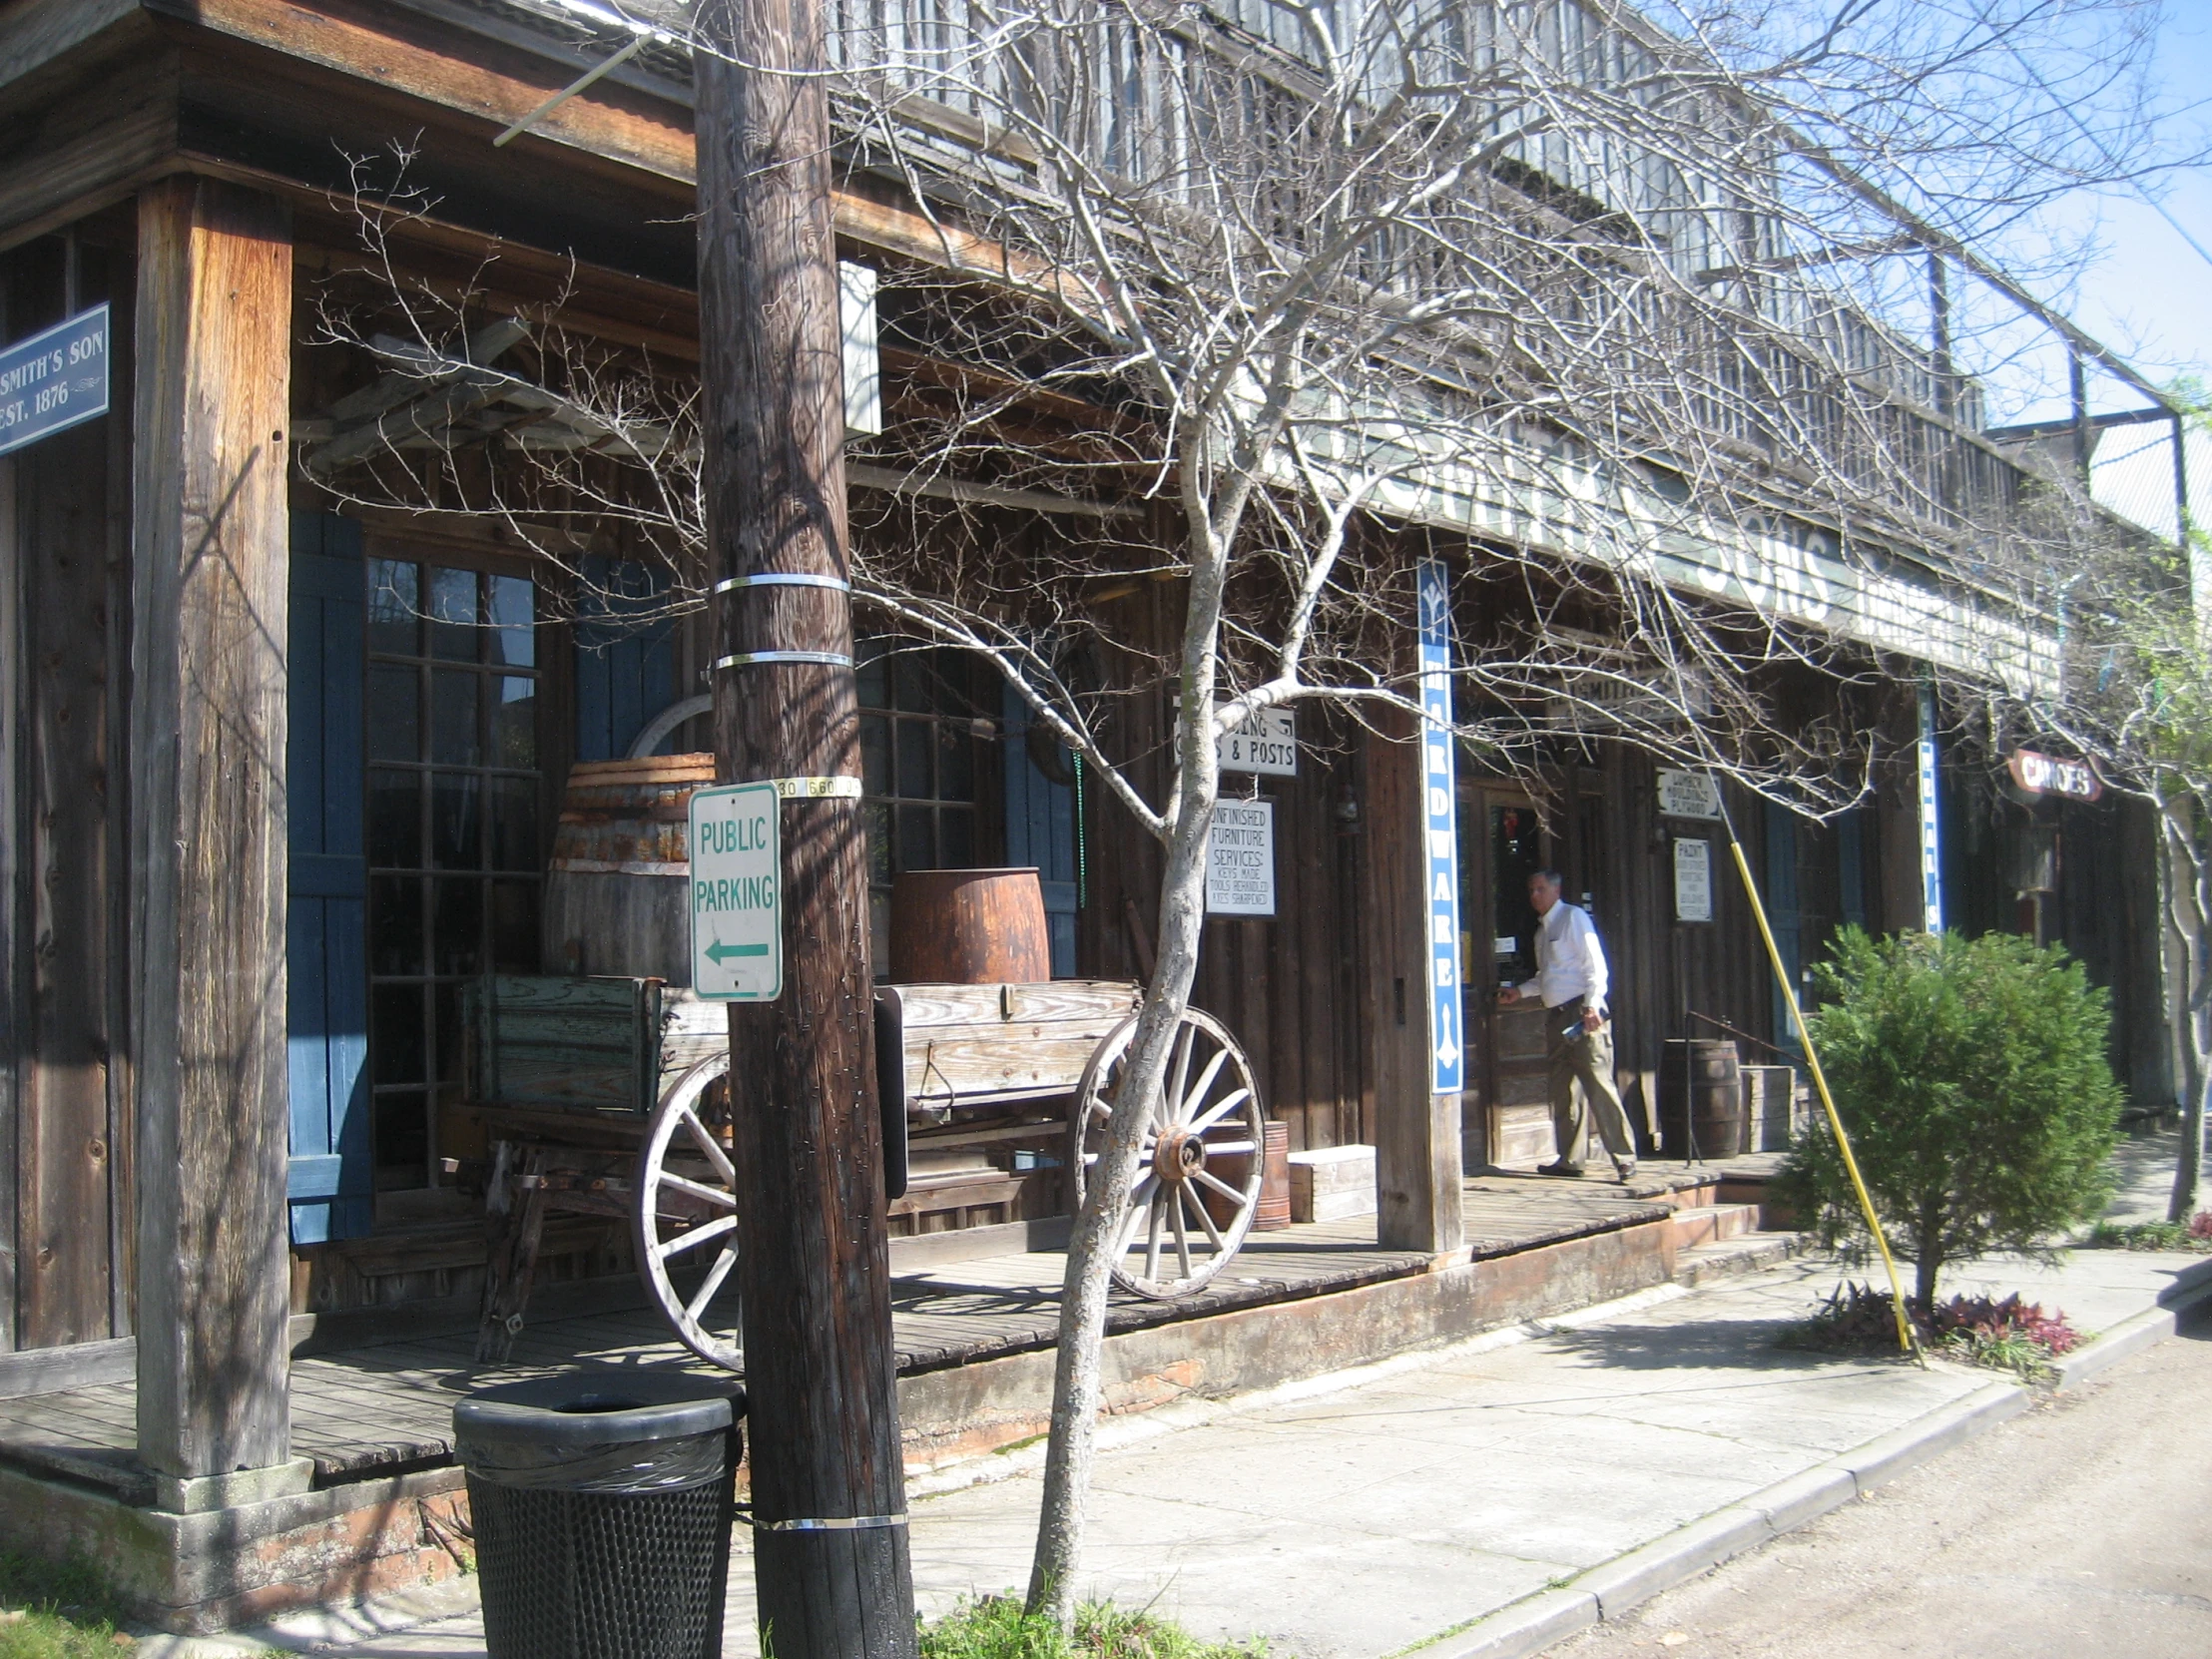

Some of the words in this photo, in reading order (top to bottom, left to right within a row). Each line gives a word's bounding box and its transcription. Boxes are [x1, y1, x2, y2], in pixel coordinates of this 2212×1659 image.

[0, 349, 63, 395] SMITH'S
[70, 330, 104, 365] SON
[35, 381, 68, 415] 1876
[1380, 387, 1660, 574] SMITHS
[1232, 740, 1240, 760] &
[1250, 741, 1293, 766] POSTS
[810, 781, 833, 795] 660
[2021, 756, 2090, 796] CANOES
[1211, 807, 1266, 827] UNFINISHED
[1425, 661, 1452, 986] HARDWARE
[702, 817, 766, 854] PUBLIC
[1211, 828, 1265, 846] FURNITURE
[1679, 842, 1702, 857] PAINT
[1214, 849, 1263, 866] SERVICES:
[1218, 867, 1237, 878] KEYS
[1241, 868, 1260, 879] MADE
[697, 875, 773, 912] PARKING
